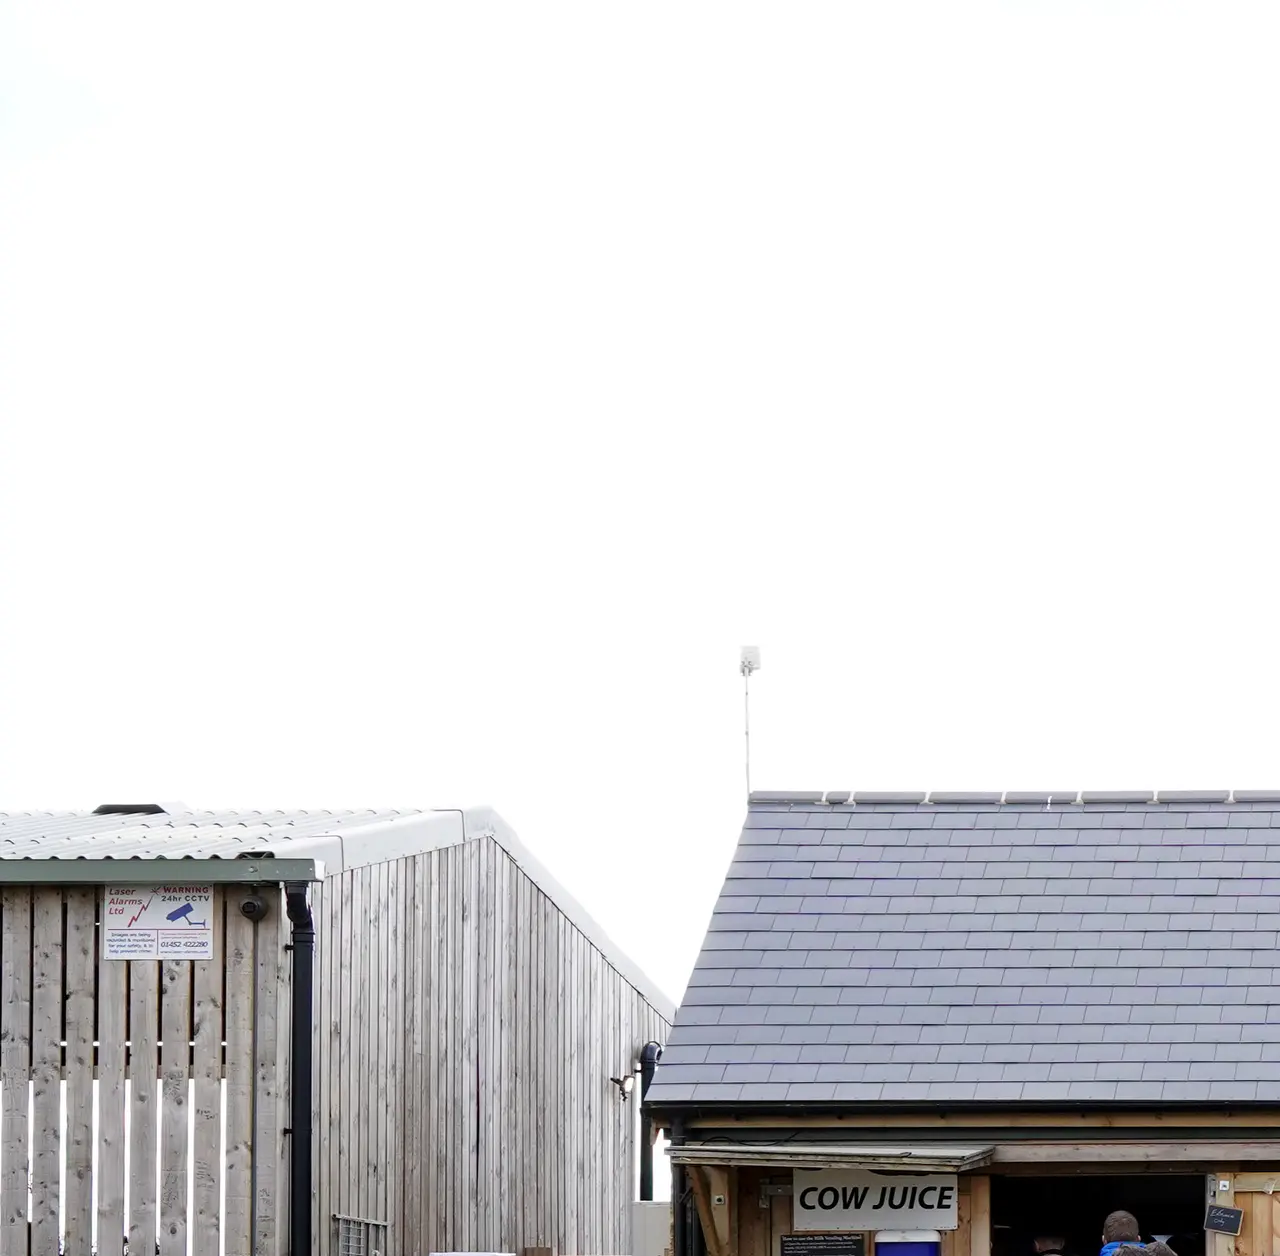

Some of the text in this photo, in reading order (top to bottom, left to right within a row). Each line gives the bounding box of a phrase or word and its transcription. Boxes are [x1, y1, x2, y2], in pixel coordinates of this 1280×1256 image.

[109, 907, 125, 915] Ltd
[799, 1186, 955, 1210] COW JUICE
